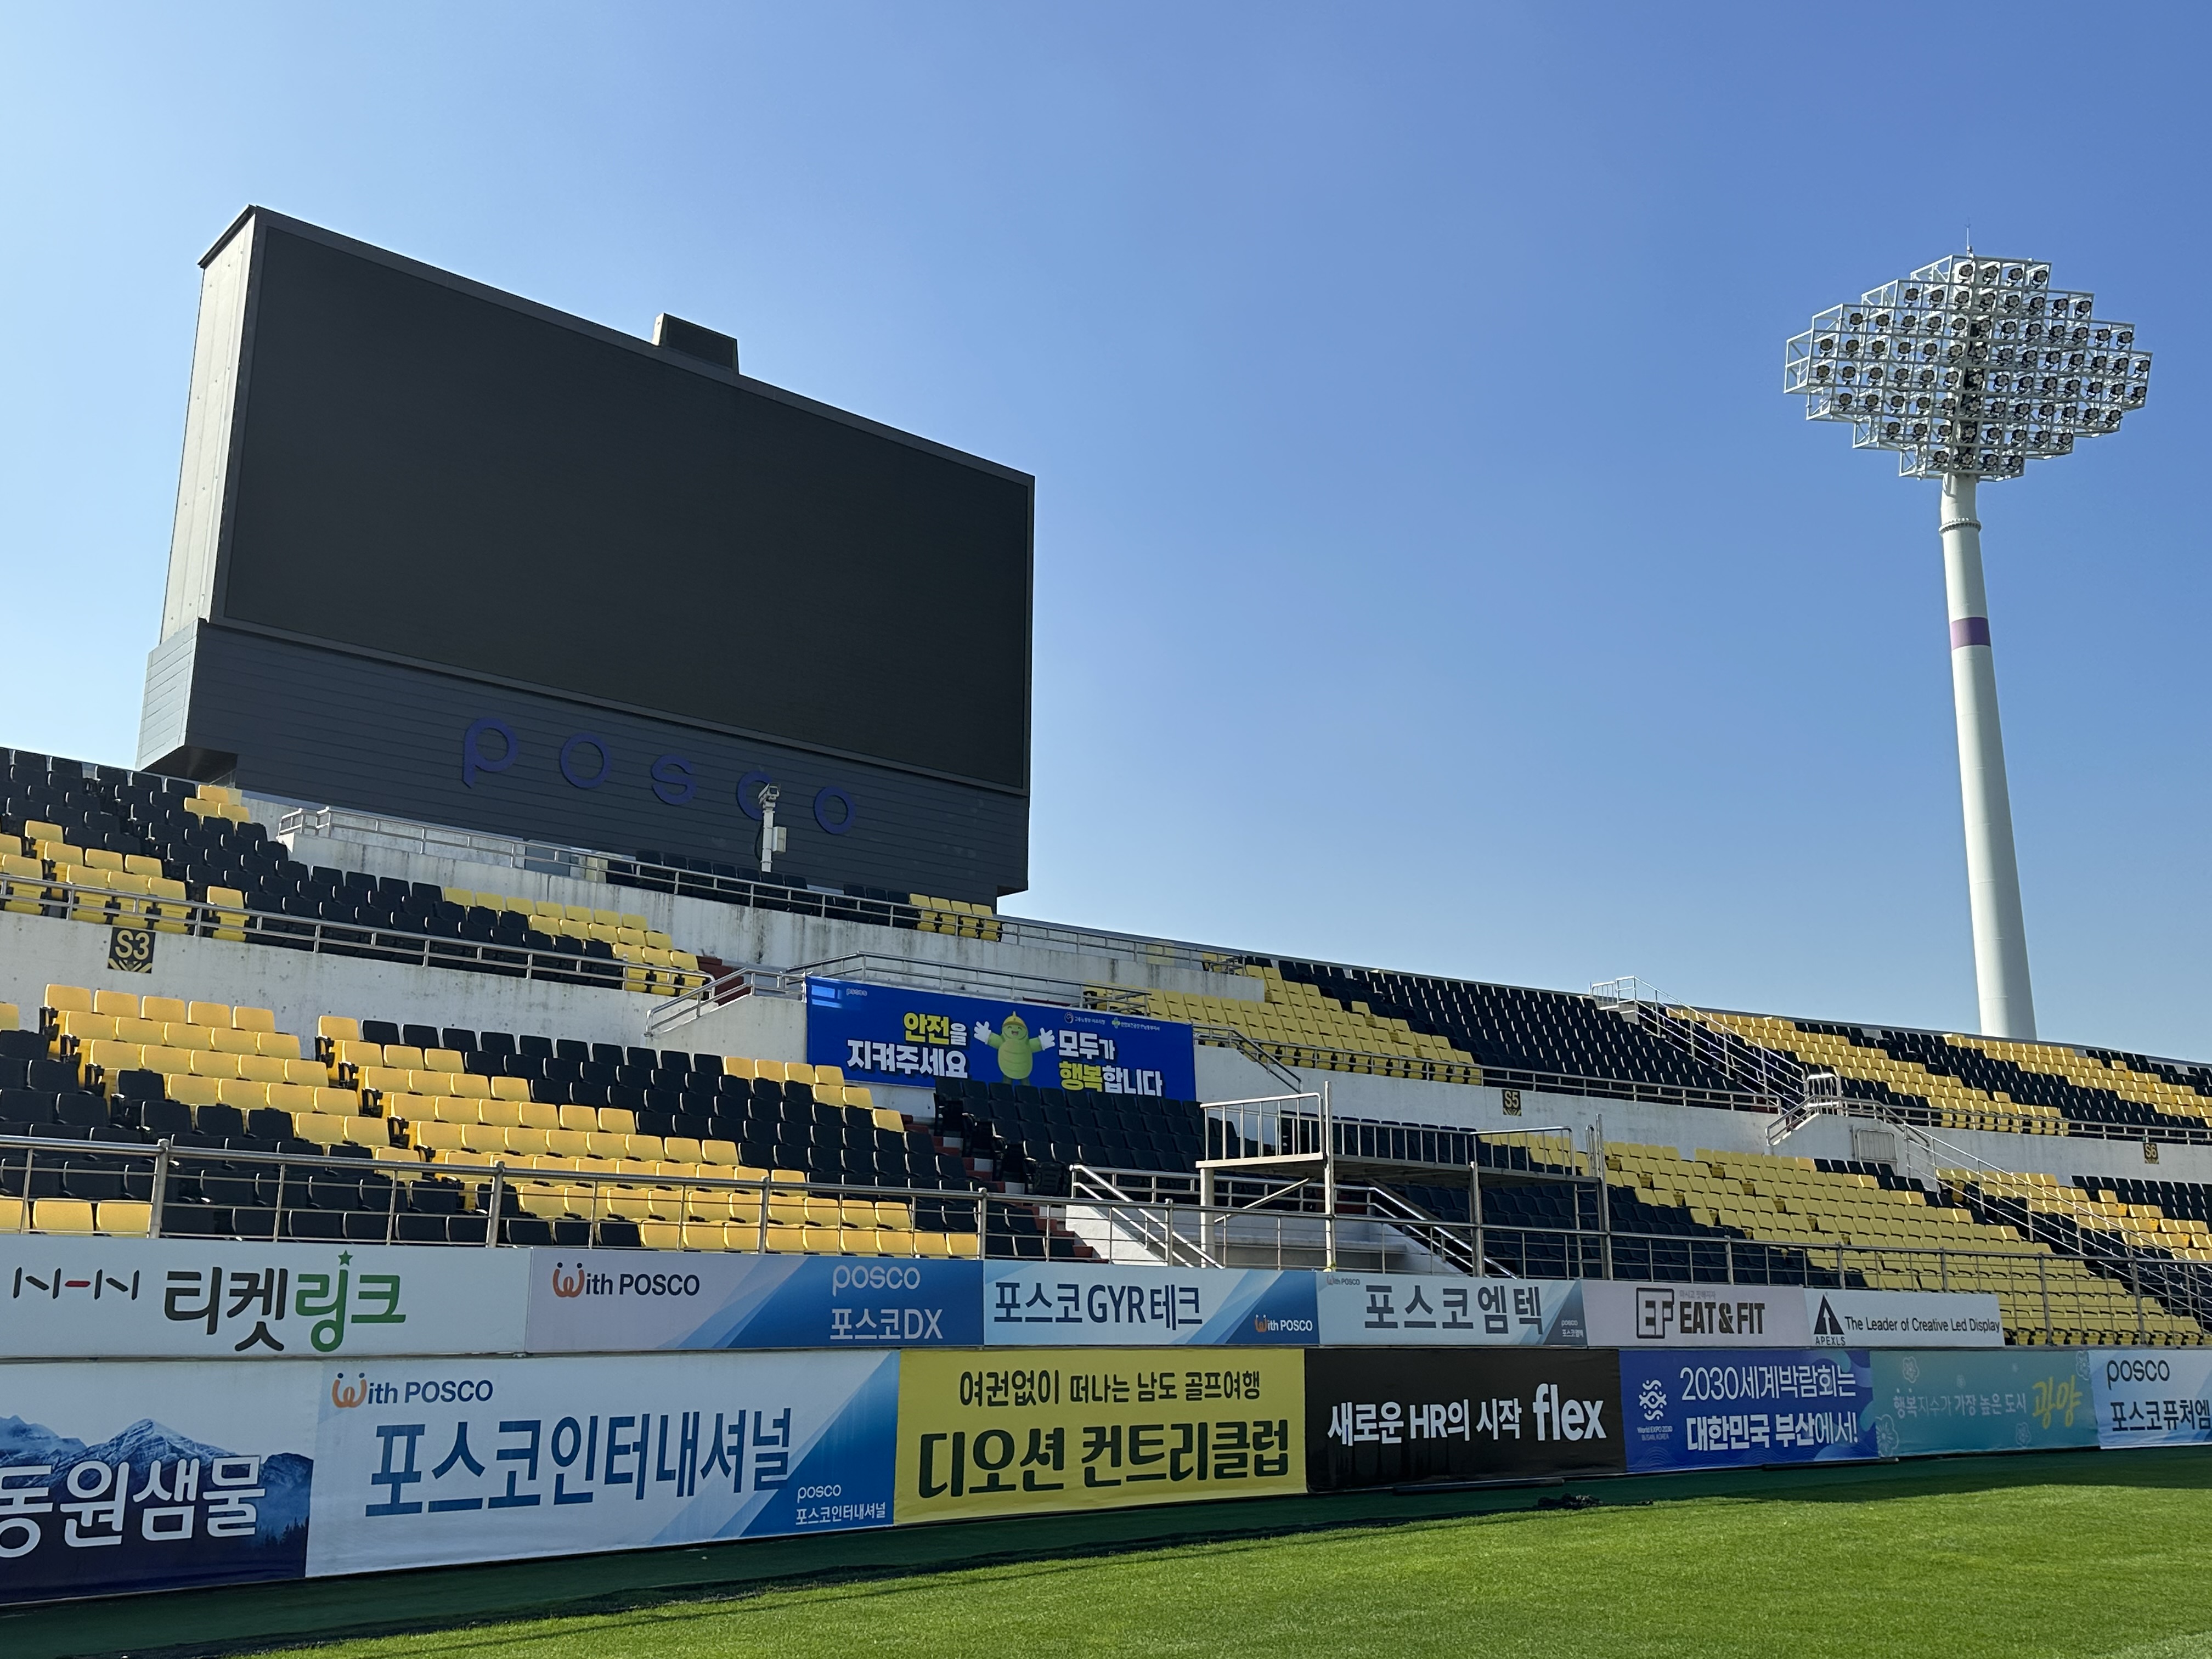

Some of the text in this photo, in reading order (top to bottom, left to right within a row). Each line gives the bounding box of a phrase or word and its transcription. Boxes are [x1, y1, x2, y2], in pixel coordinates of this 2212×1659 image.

[115, 929, 150, 960] S3
[904, 1012, 967, 1046] 안전을
[1059, 1030, 1115, 1060] 모두가
[847, 1040, 968, 1079] 지켜주세요
[1059, 1060, 1163, 1097] 행복합니다
[1504, 1090, 1519, 1108] S5
[2145, 1144, 2157, 1158] S6
[619, 1273, 700, 1296] POSCO
[832, 1265, 921, 1297] posco
[164, 1256, 407, 1352] 티켓링크
[994, 1282, 1203, 1331] 포스코GYR테크
[1364, 1285, 1543, 1335] 포스코엠텍
[830, 1308, 944, 1340] 포스코DX
[1280, 1319, 1313, 1331] POSCO
[1845, 1316, 2000, 1333] The Leader of Creative Led Display
[1815, 1336, 1846, 1346] APEXLS
[960, 1369, 1261, 1407] 여권없이 떠나는 남도 골프여행
[1680, 1364, 1857, 1401] 2030세계박람회는
[2107, 1359, 2170, 1390] posco
[404, 1380, 493, 1404] POSCO
[1893, 1374, 2083, 1429] 행복지수가 가장 높은 도시 광양
[1327, 1383, 1607, 1447] 새로운 HR의 시작 flex
[1686, 1411, 1859, 1451] 대한민국 부산에서!
[2111, 1400, 2211, 1431] 포스코퓨처엠
[365, 1408, 792, 1517] 포스코인터내셔널
[918, 1419, 1289, 1498] 디오션 컨트리클럽
[0, 1455, 266, 1558] 동원샘물
[797, 1485, 842, 1503] posco
[795, 1502, 886, 1525] 포스코인터내셔널
